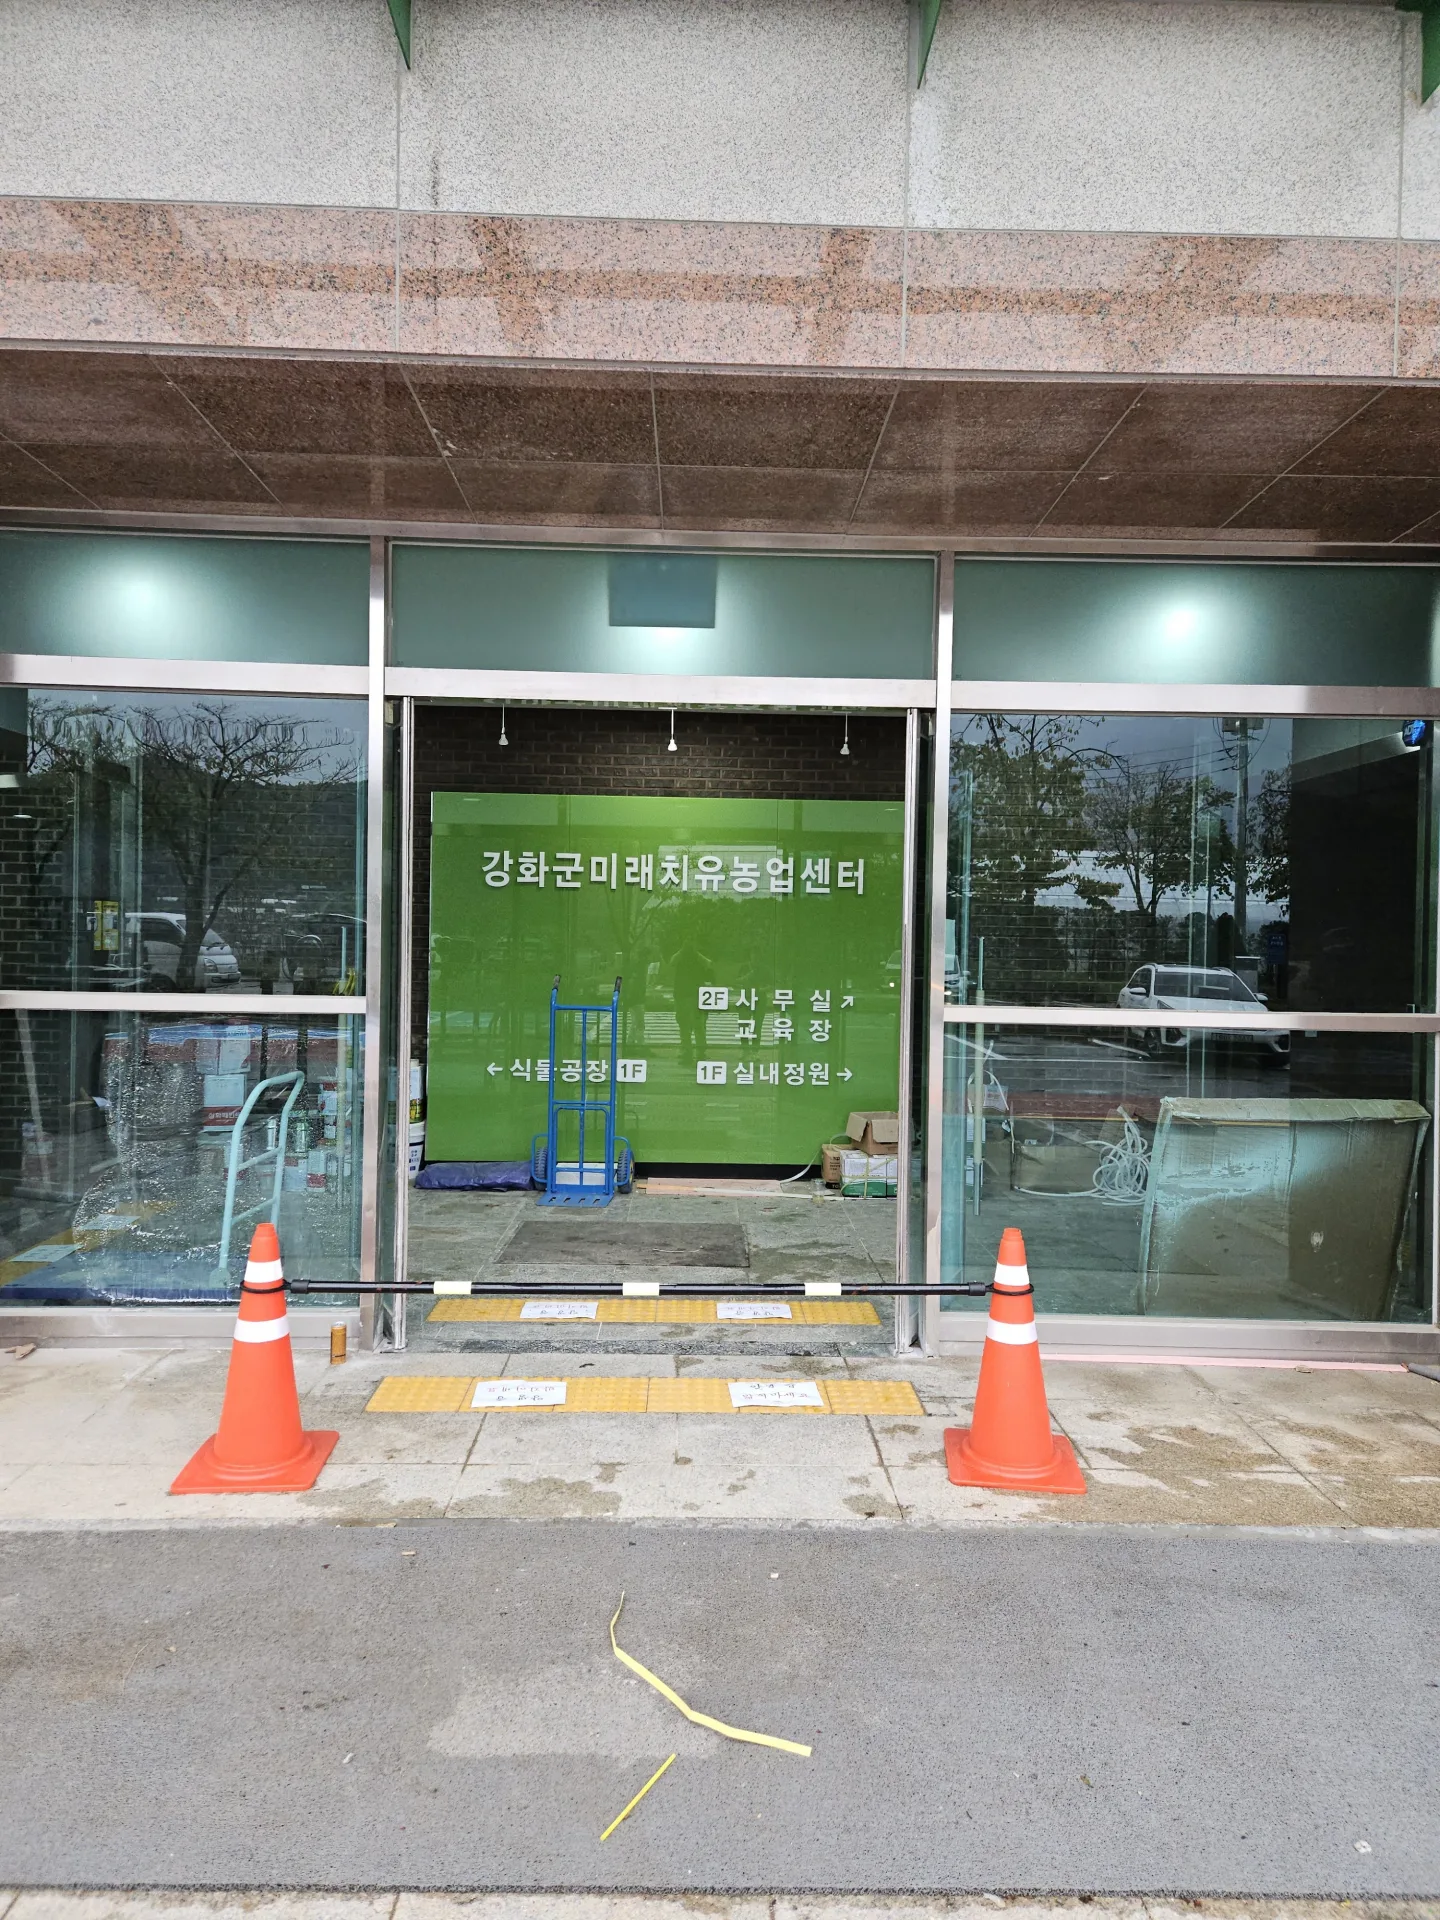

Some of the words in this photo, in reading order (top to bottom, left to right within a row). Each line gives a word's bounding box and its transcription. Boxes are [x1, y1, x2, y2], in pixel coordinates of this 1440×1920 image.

[481, 850, 865, 895] 강화군미래치유농업센터
[701, 990, 726, 1007] 2F
[510, 1058, 609, 1083] 식물공장
[619, 1062, 644, 1080] 1F
[699, 1064, 724, 1082] 1F
[733, 1062, 830, 1086] 실내정원
